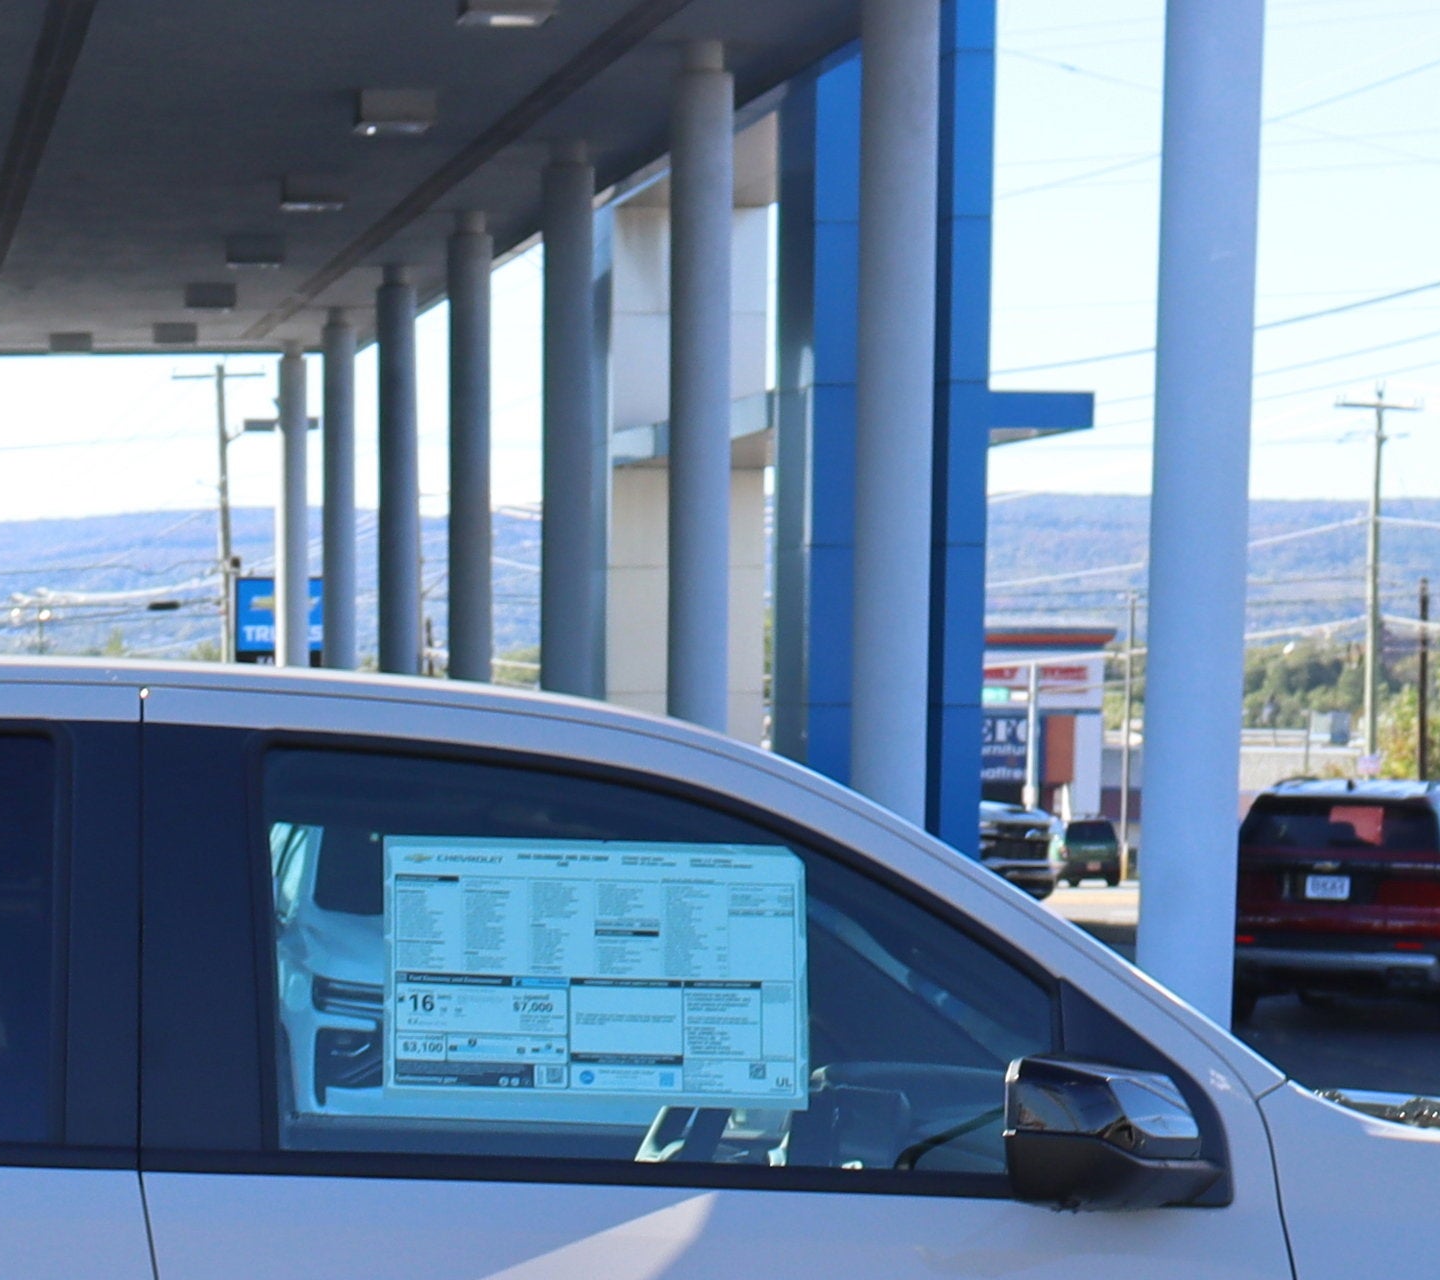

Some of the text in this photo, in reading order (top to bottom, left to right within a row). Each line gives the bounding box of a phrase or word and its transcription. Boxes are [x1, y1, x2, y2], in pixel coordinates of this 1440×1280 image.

[436, 854, 503, 864] CHEVROLET
[409, 994, 435, 1012] 16
[513, 1001, 553, 1013] $7,000
